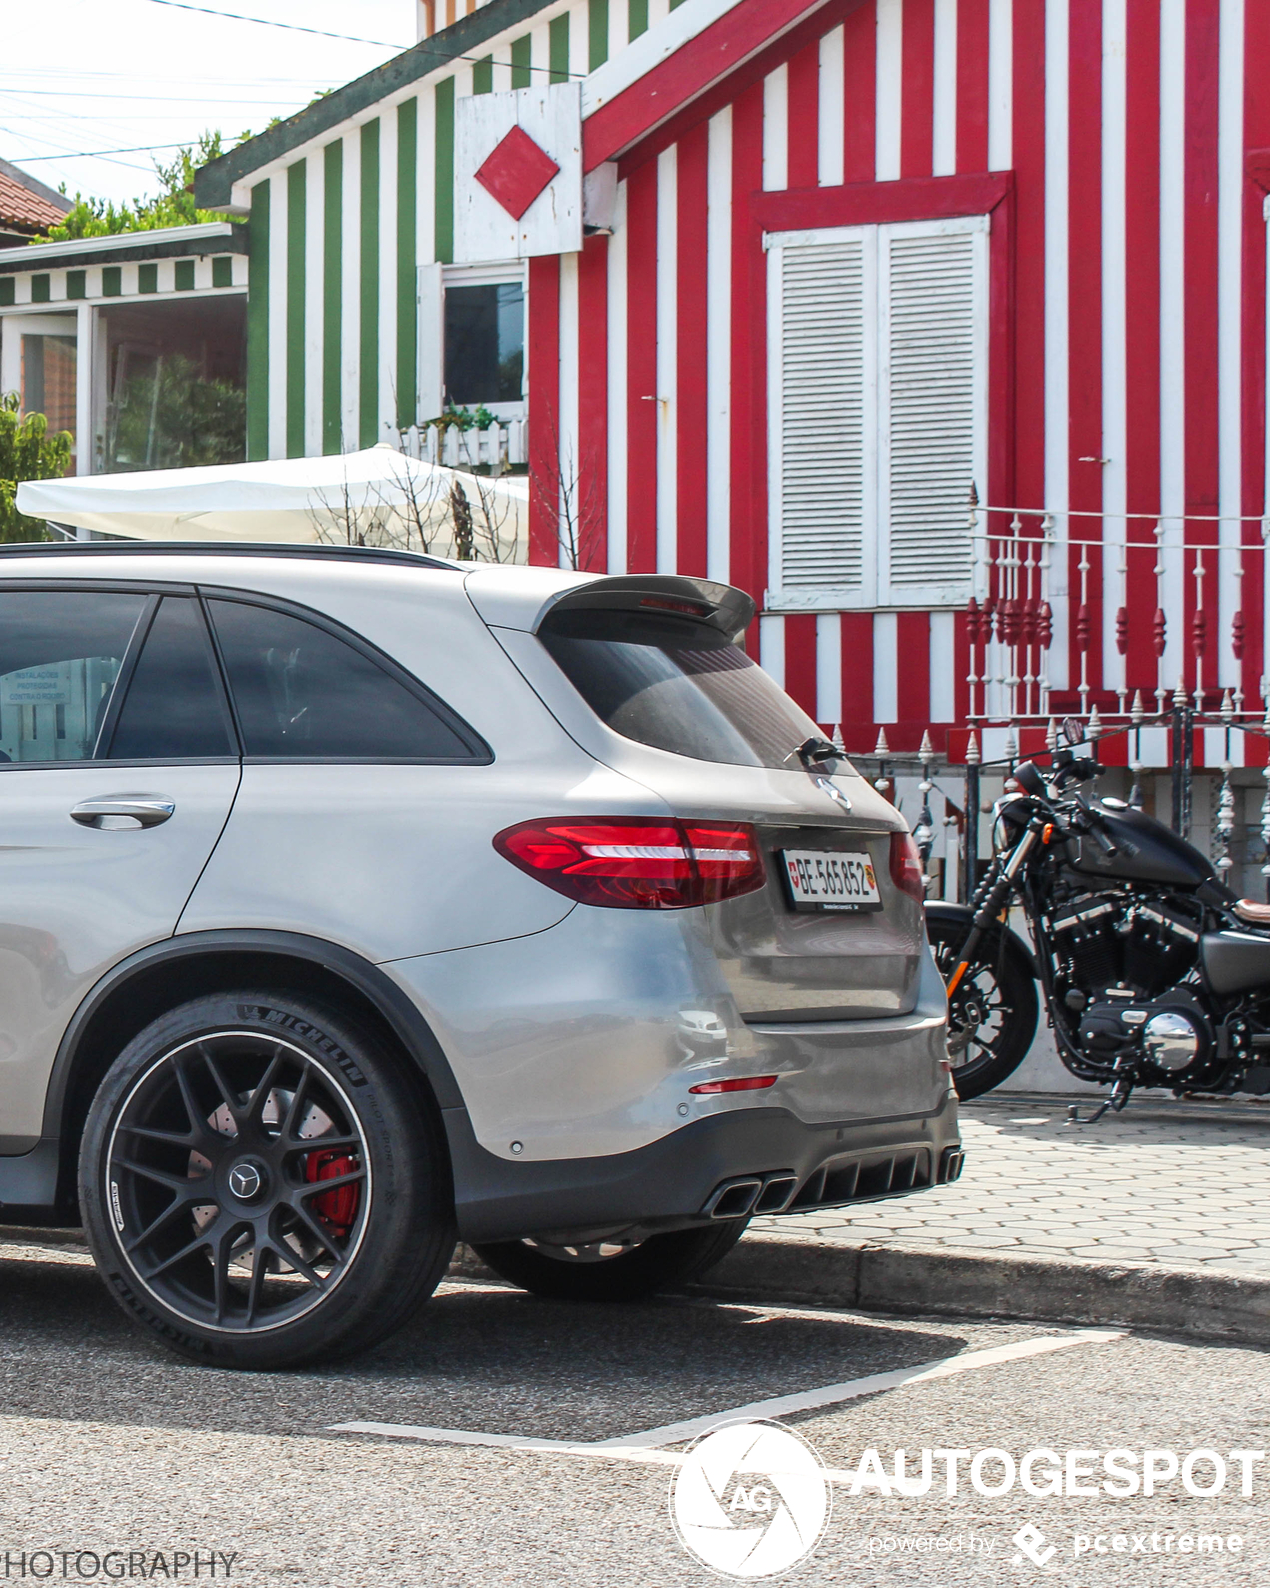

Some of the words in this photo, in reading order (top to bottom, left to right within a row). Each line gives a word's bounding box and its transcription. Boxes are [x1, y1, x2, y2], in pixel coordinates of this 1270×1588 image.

[264, 1009, 364, 1082] MICHELIN
[367, 1094, 384, 1124] PILOT
[381, 1130, 393, 1168] SPORT
